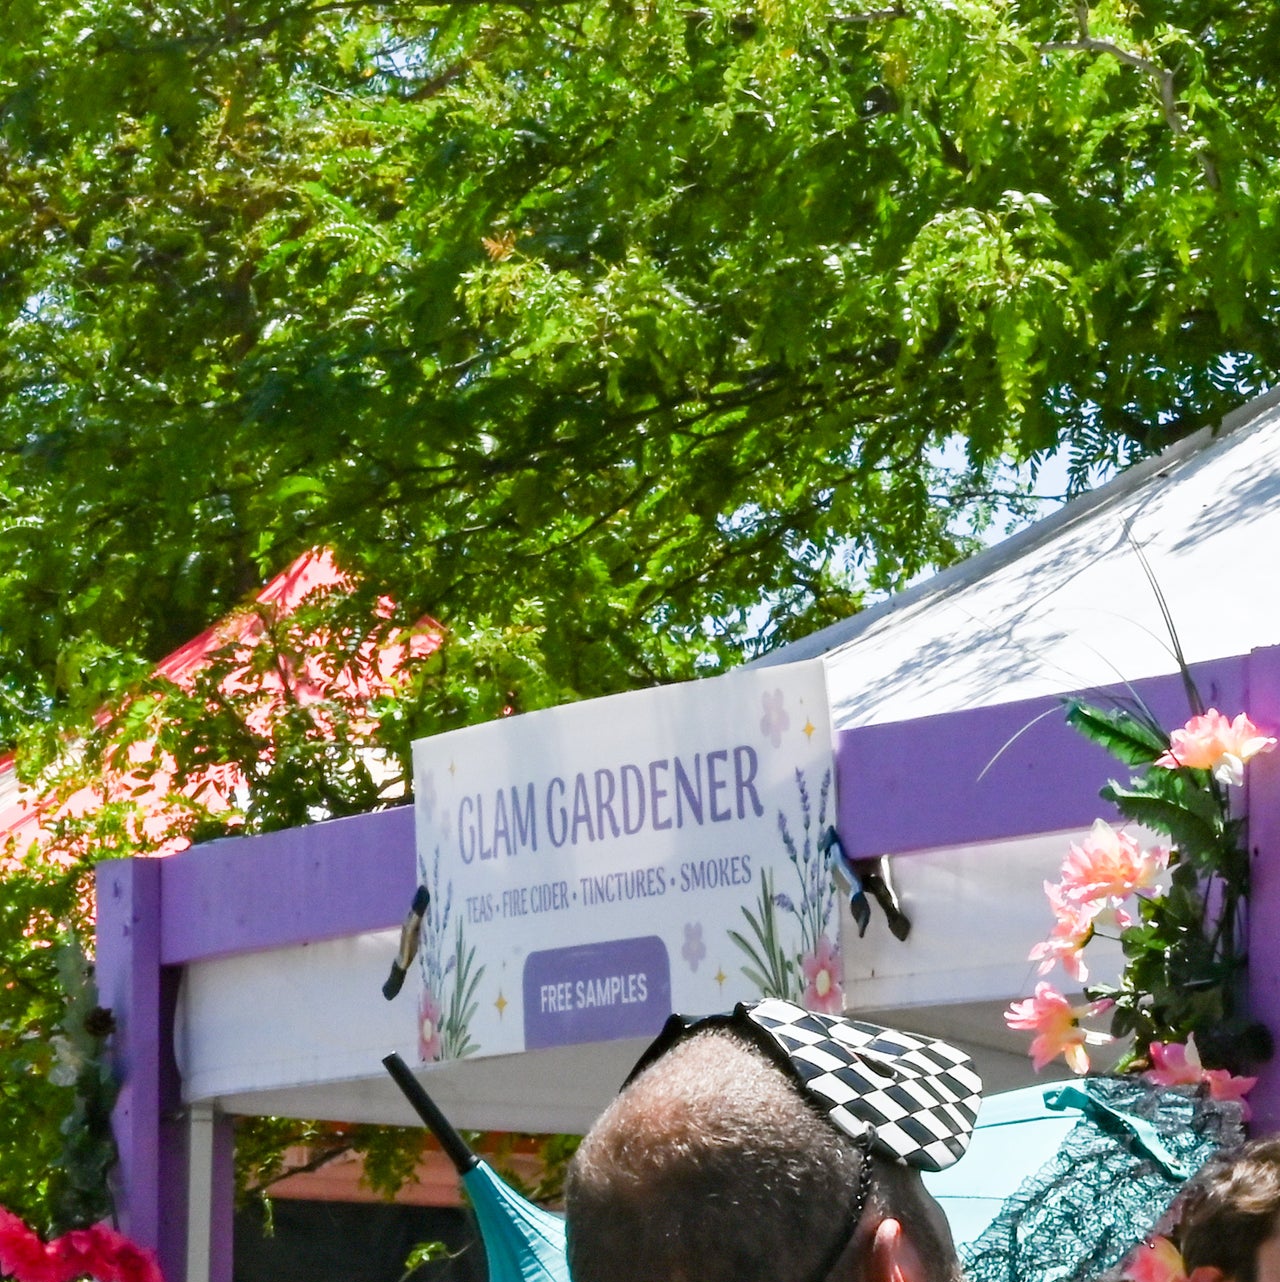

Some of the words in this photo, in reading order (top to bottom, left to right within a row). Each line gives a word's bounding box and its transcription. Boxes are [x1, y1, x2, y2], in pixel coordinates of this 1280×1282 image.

[458, 782, 537, 865] GLAM
[547, 745, 764, 848] GARDENER
[466, 894, 493, 923] TEAS
[503, 889, 528, 918] FIRE
[530, 880, 569, 914] CIDER
[580, 867, 666, 905] TINCTURES
[680, 854, 752, 892] SMOKES
[540, 985, 573, 1013] FREE
[576, 973, 647, 1008] SAMPLES
